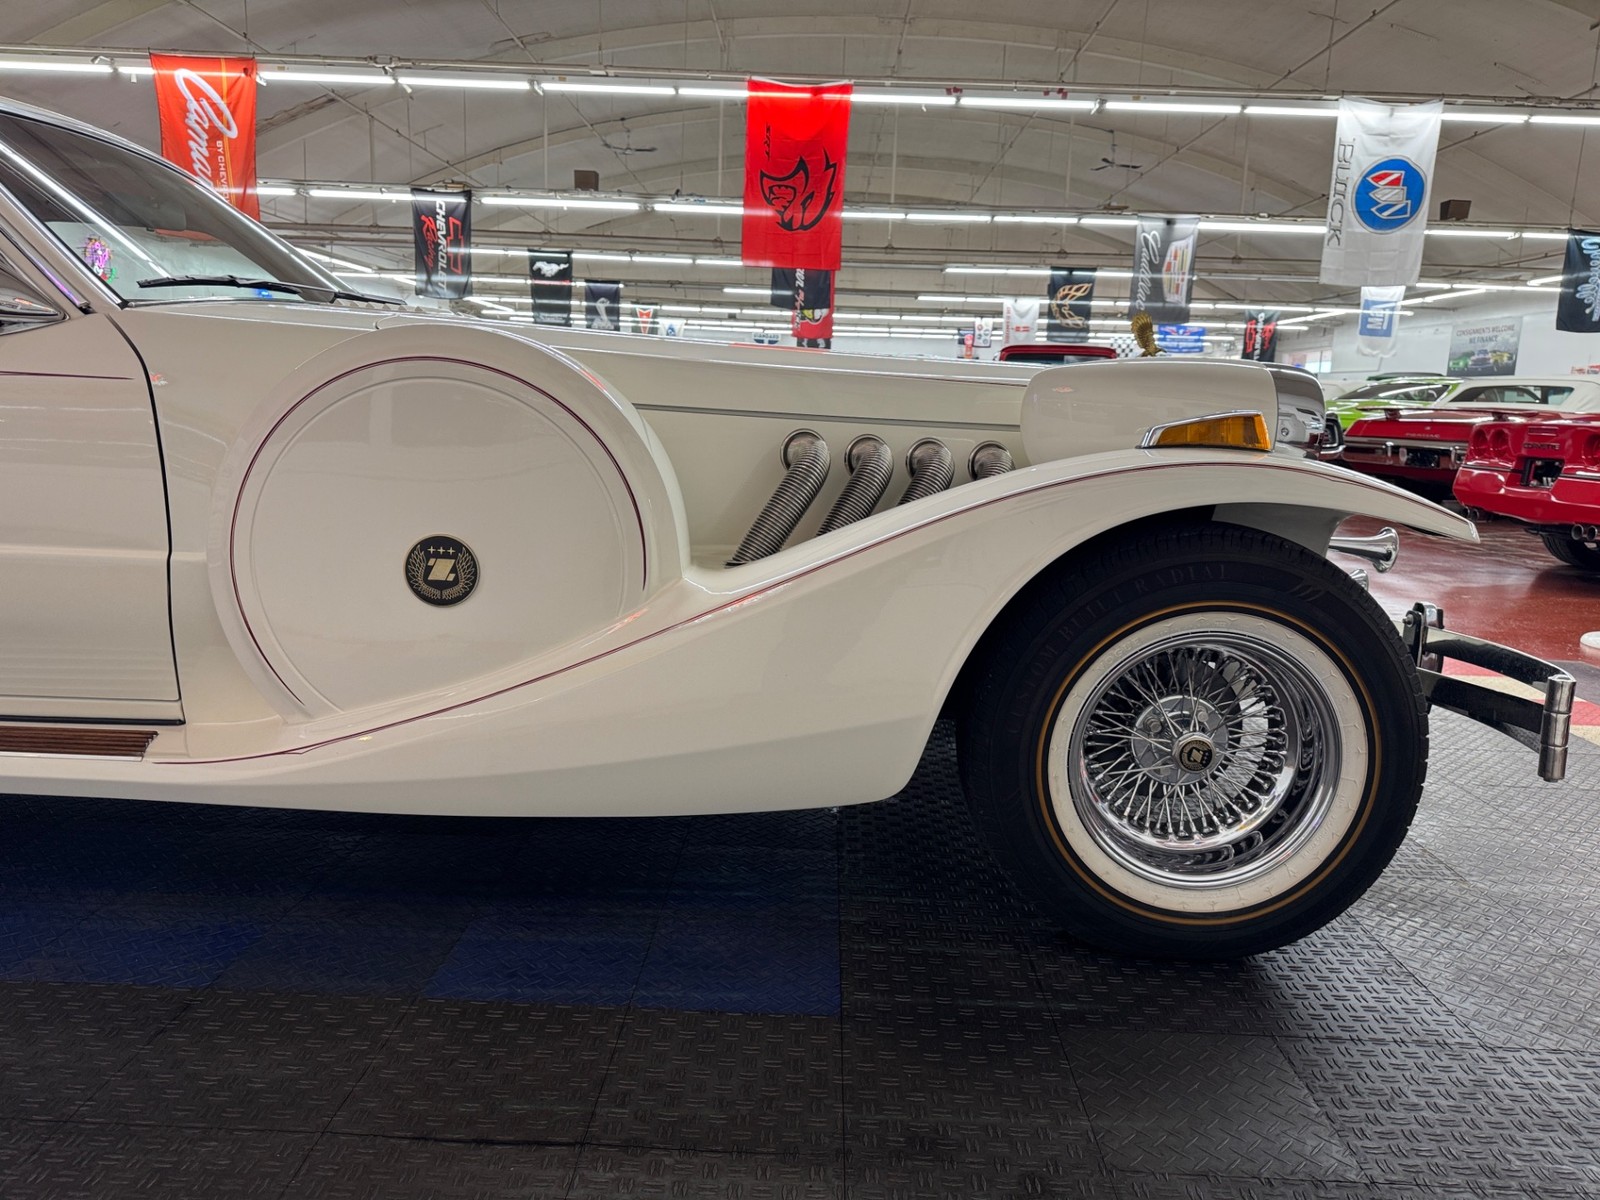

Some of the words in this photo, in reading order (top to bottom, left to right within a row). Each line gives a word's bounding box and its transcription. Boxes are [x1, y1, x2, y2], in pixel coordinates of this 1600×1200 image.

[174, 68, 239, 189] Camar
[216, 140, 224, 154] BY
[217, 155, 230, 203] CHEVRO
[1327, 137, 1356, 247] BUICK
[421, 214, 438, 271] Racing
[436, 199, 448, 292] CHEVROLET
[1135, 230, 1161, 311] Cadillac
[1477, 334, 1498, 344] FINANCE
[1523, 442, 1560, 450] CORVETTE
